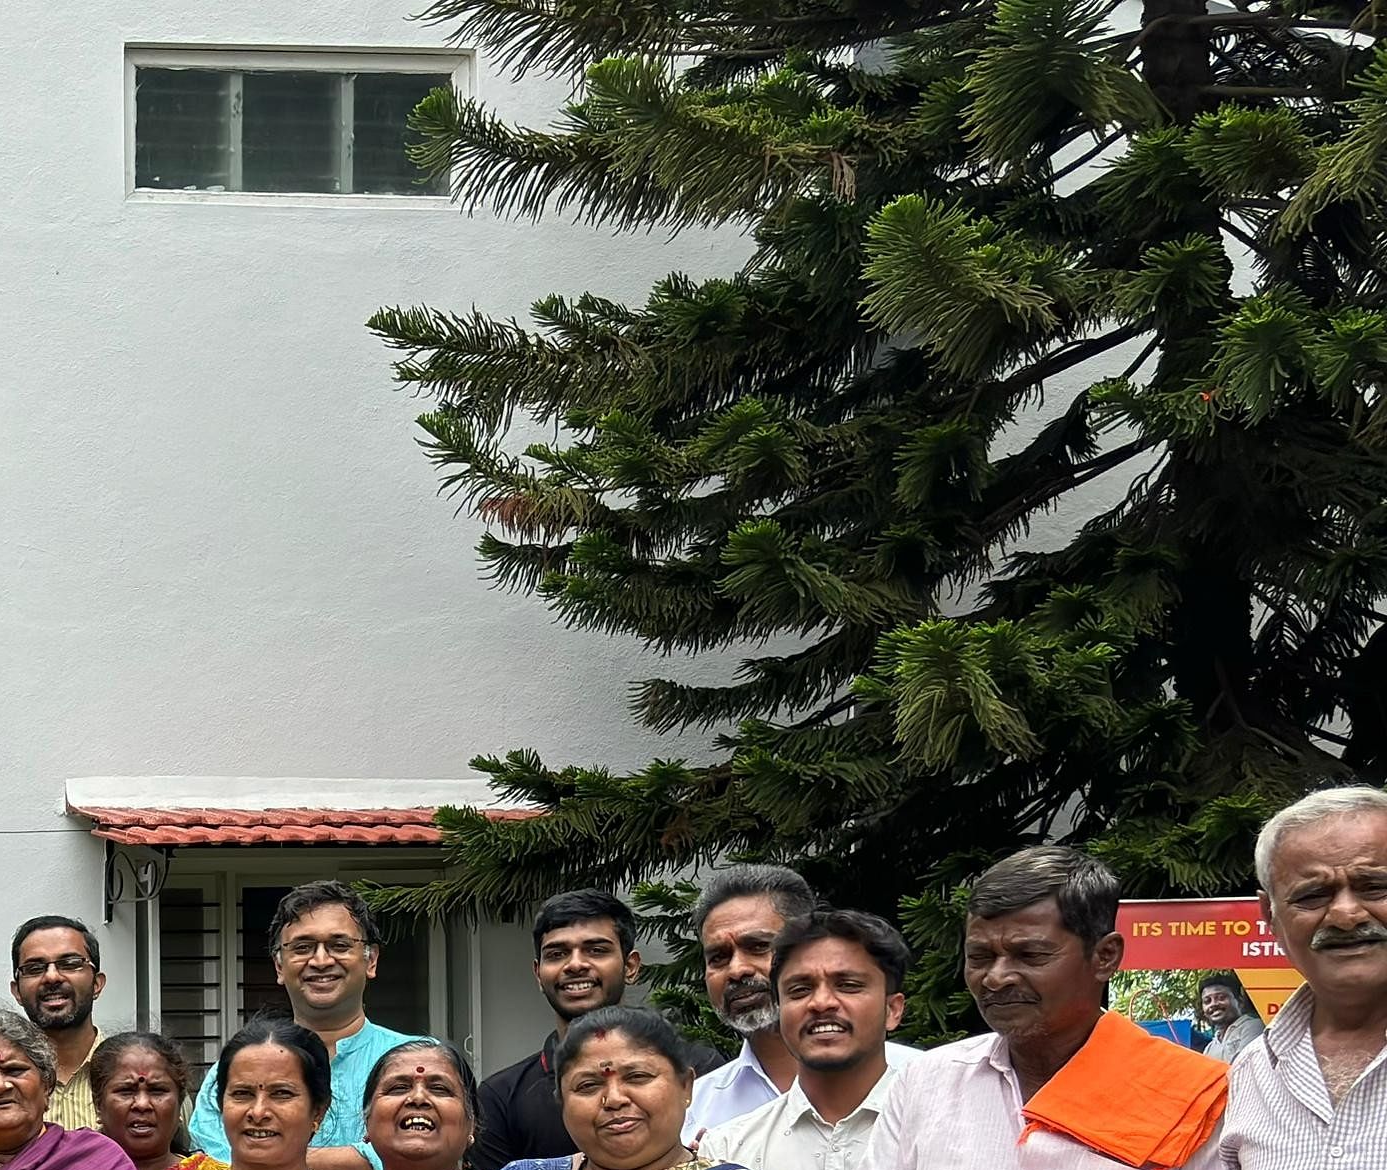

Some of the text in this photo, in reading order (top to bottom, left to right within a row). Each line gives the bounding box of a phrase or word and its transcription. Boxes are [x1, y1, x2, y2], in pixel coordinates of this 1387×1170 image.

[1132, 920, 1273, 938] ITS TIME TO T
